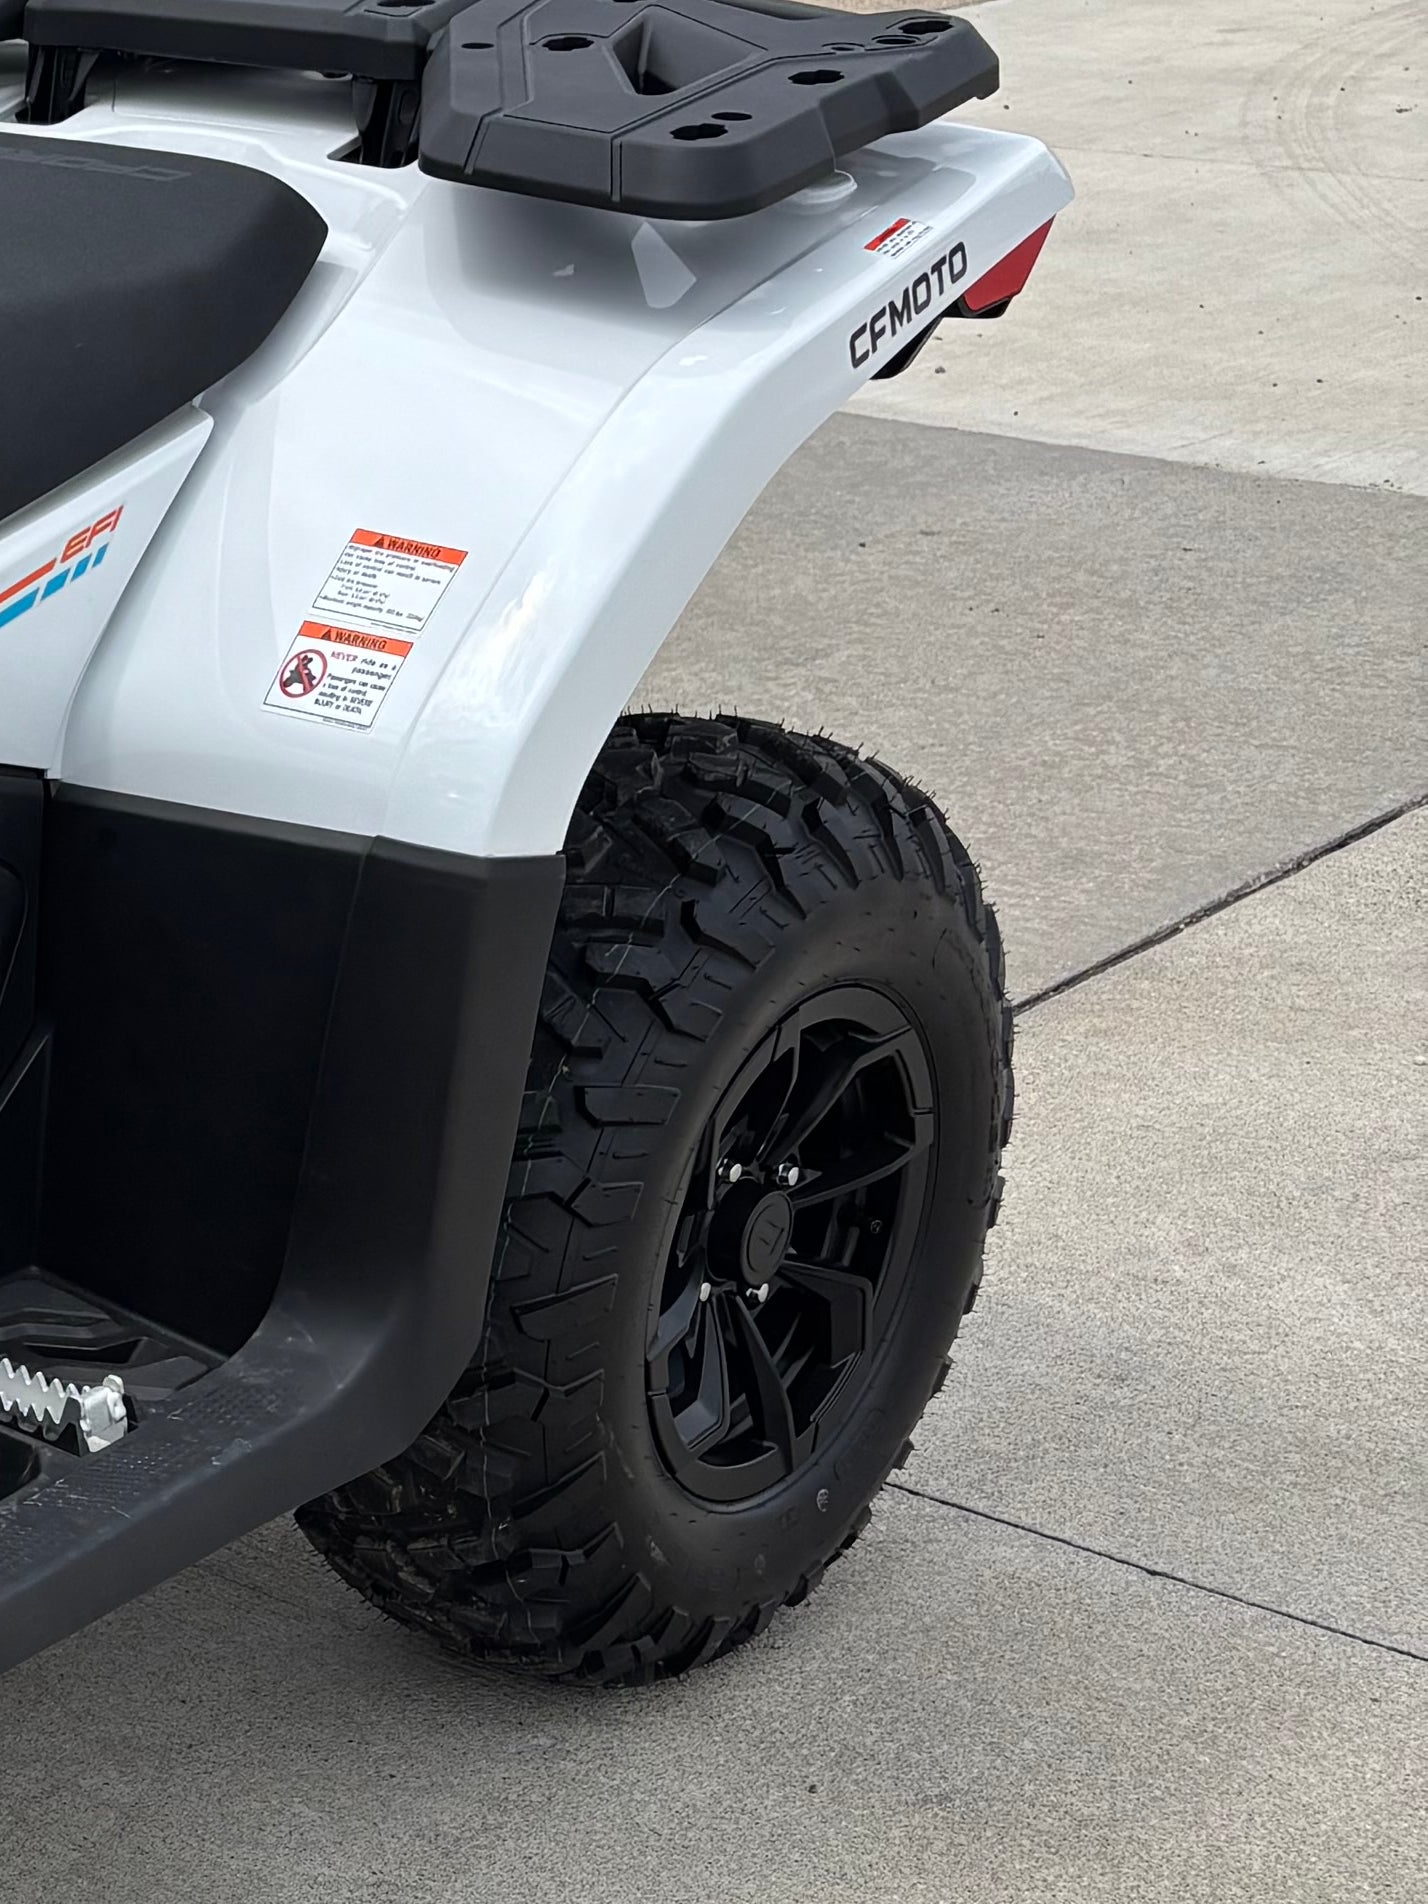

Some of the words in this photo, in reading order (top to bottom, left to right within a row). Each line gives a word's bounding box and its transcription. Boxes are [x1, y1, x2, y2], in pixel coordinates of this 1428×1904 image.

[848, 241, 968, 369] CFMOTO
[60, 504, 124, 564] EFI
[387, 536, 442, 559] WARNING
[334, 630, 388, 650] WARNING
